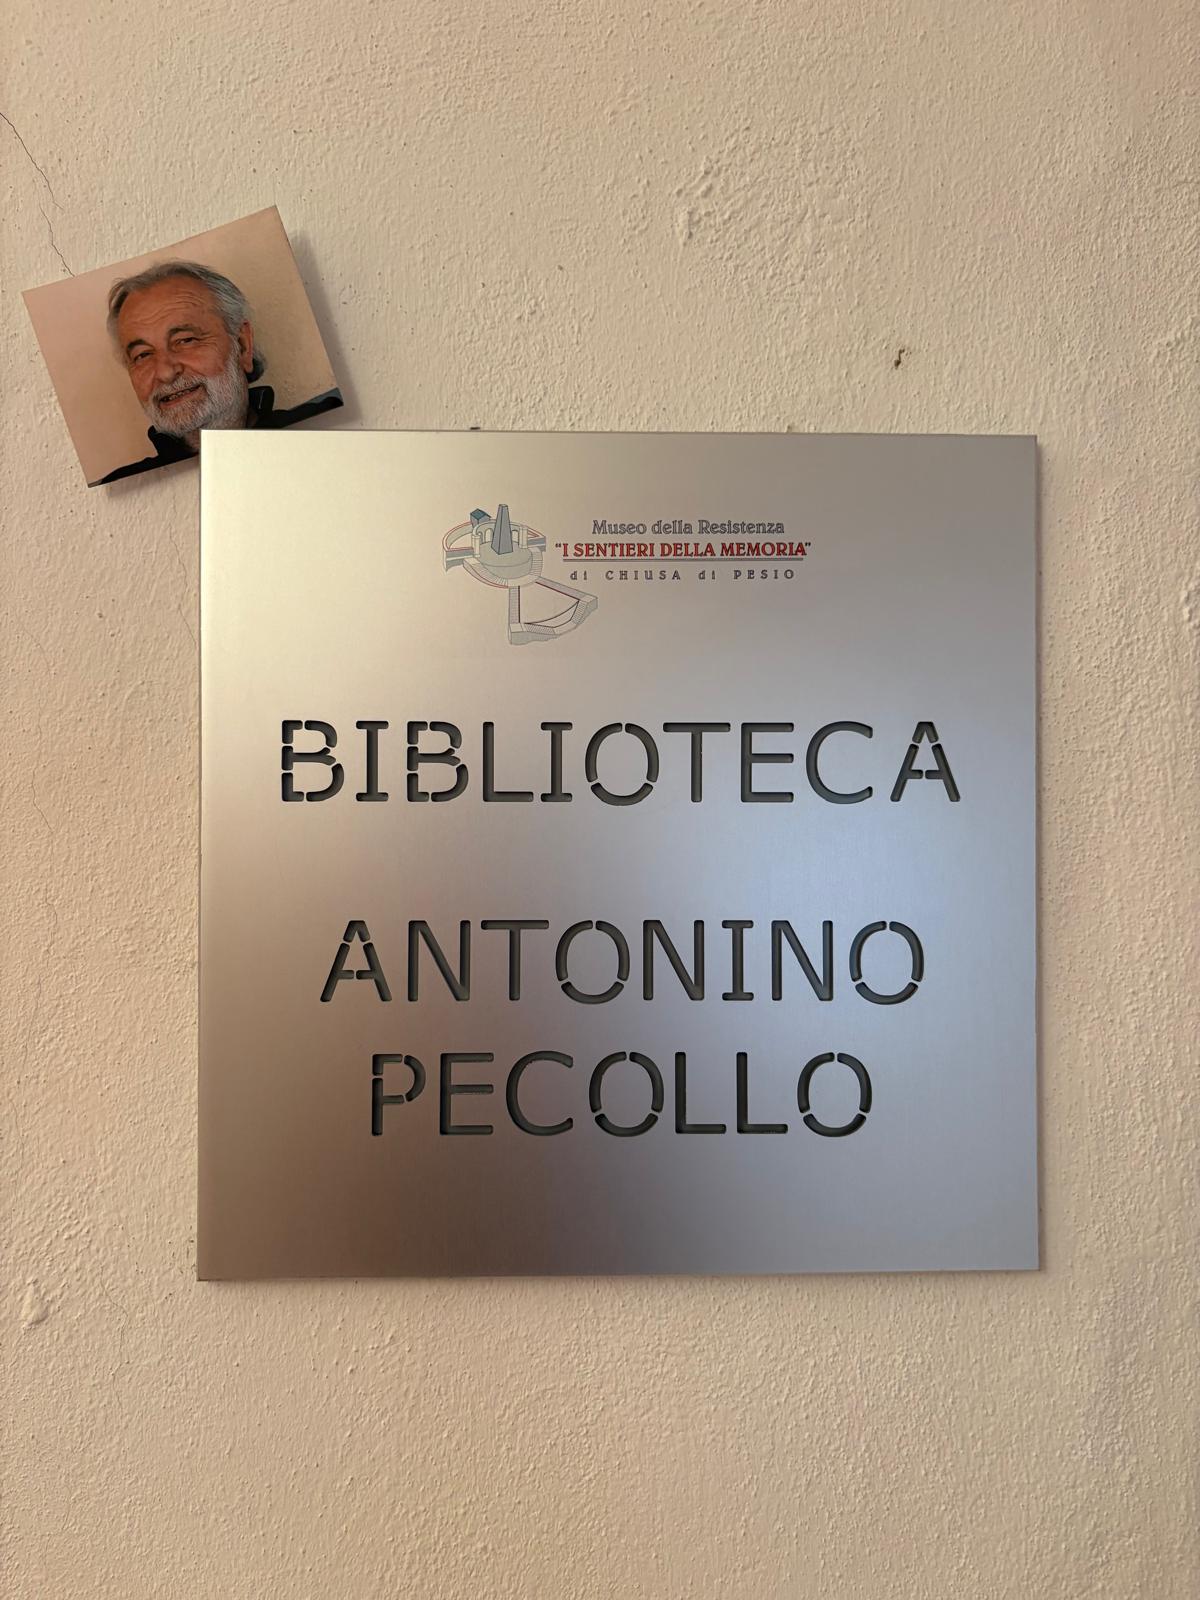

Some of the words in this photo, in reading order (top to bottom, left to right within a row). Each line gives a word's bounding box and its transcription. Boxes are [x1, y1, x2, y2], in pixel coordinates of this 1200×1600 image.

[573, 542, 656, 557] SENTIERI
[660, 542, 716, 557] DELLA
[591, 519, 647, 535] Museo
[651, 519, 693, 535] della
[698, 519, 785, 535] Resistenza
[569, 570, 588, 581] di
[604, 570, 681, 581] CHIUSA
[697, 569, 716, 580] di
[733, 569, 795, 580] PESIO
[281, 719, 962, 805] BIBLIOTECA
[320, 919, 925, 1004] ANTONINO
[371, 1050, 873, 1138] PECOLLO
